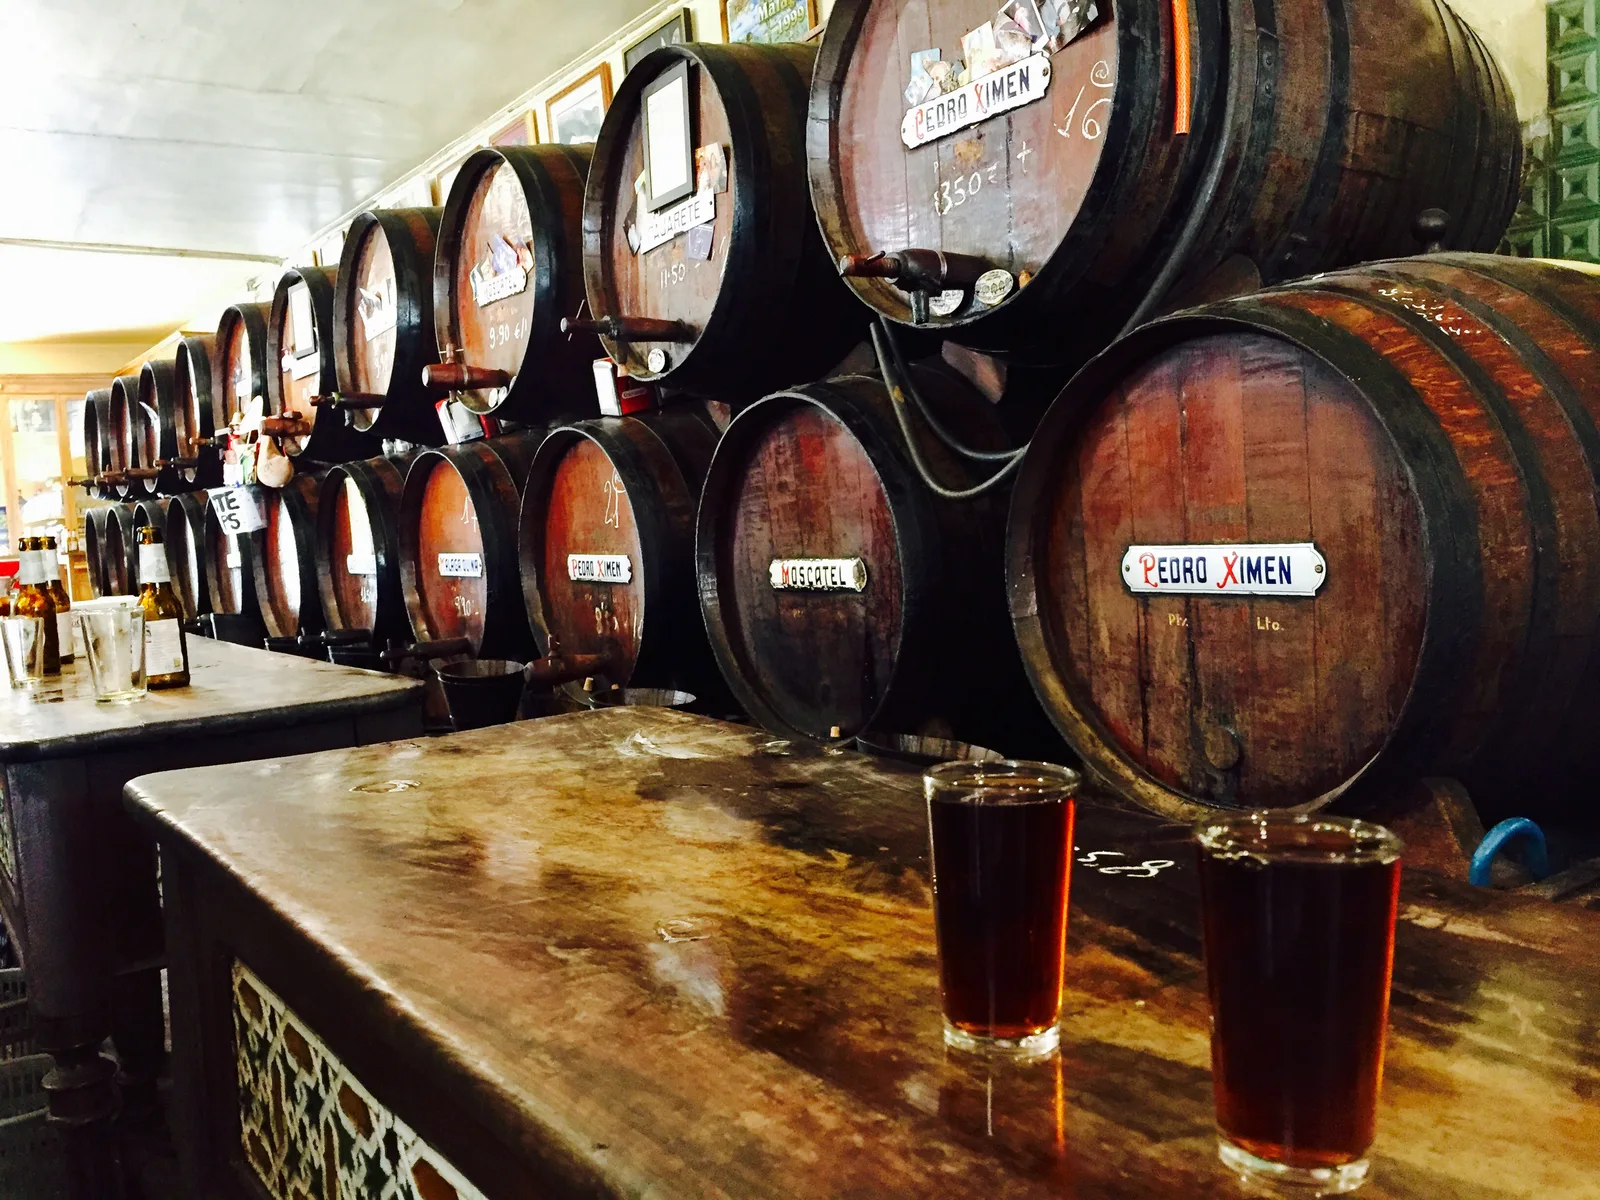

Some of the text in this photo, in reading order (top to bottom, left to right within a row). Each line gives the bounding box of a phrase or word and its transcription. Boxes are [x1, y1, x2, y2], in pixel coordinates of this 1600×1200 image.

[777, 5, 805, 35] 1999
[915, 66, 1031, 141] PEDRO XIMEN
[1057, 84, 1112, 140] 16
[571, 559, 622, 578] PEDRO XIMEN
[781, 562, 847, 586] MOSCATEL
[1138, 551, 1293, 589] PEDRO XIMEN
